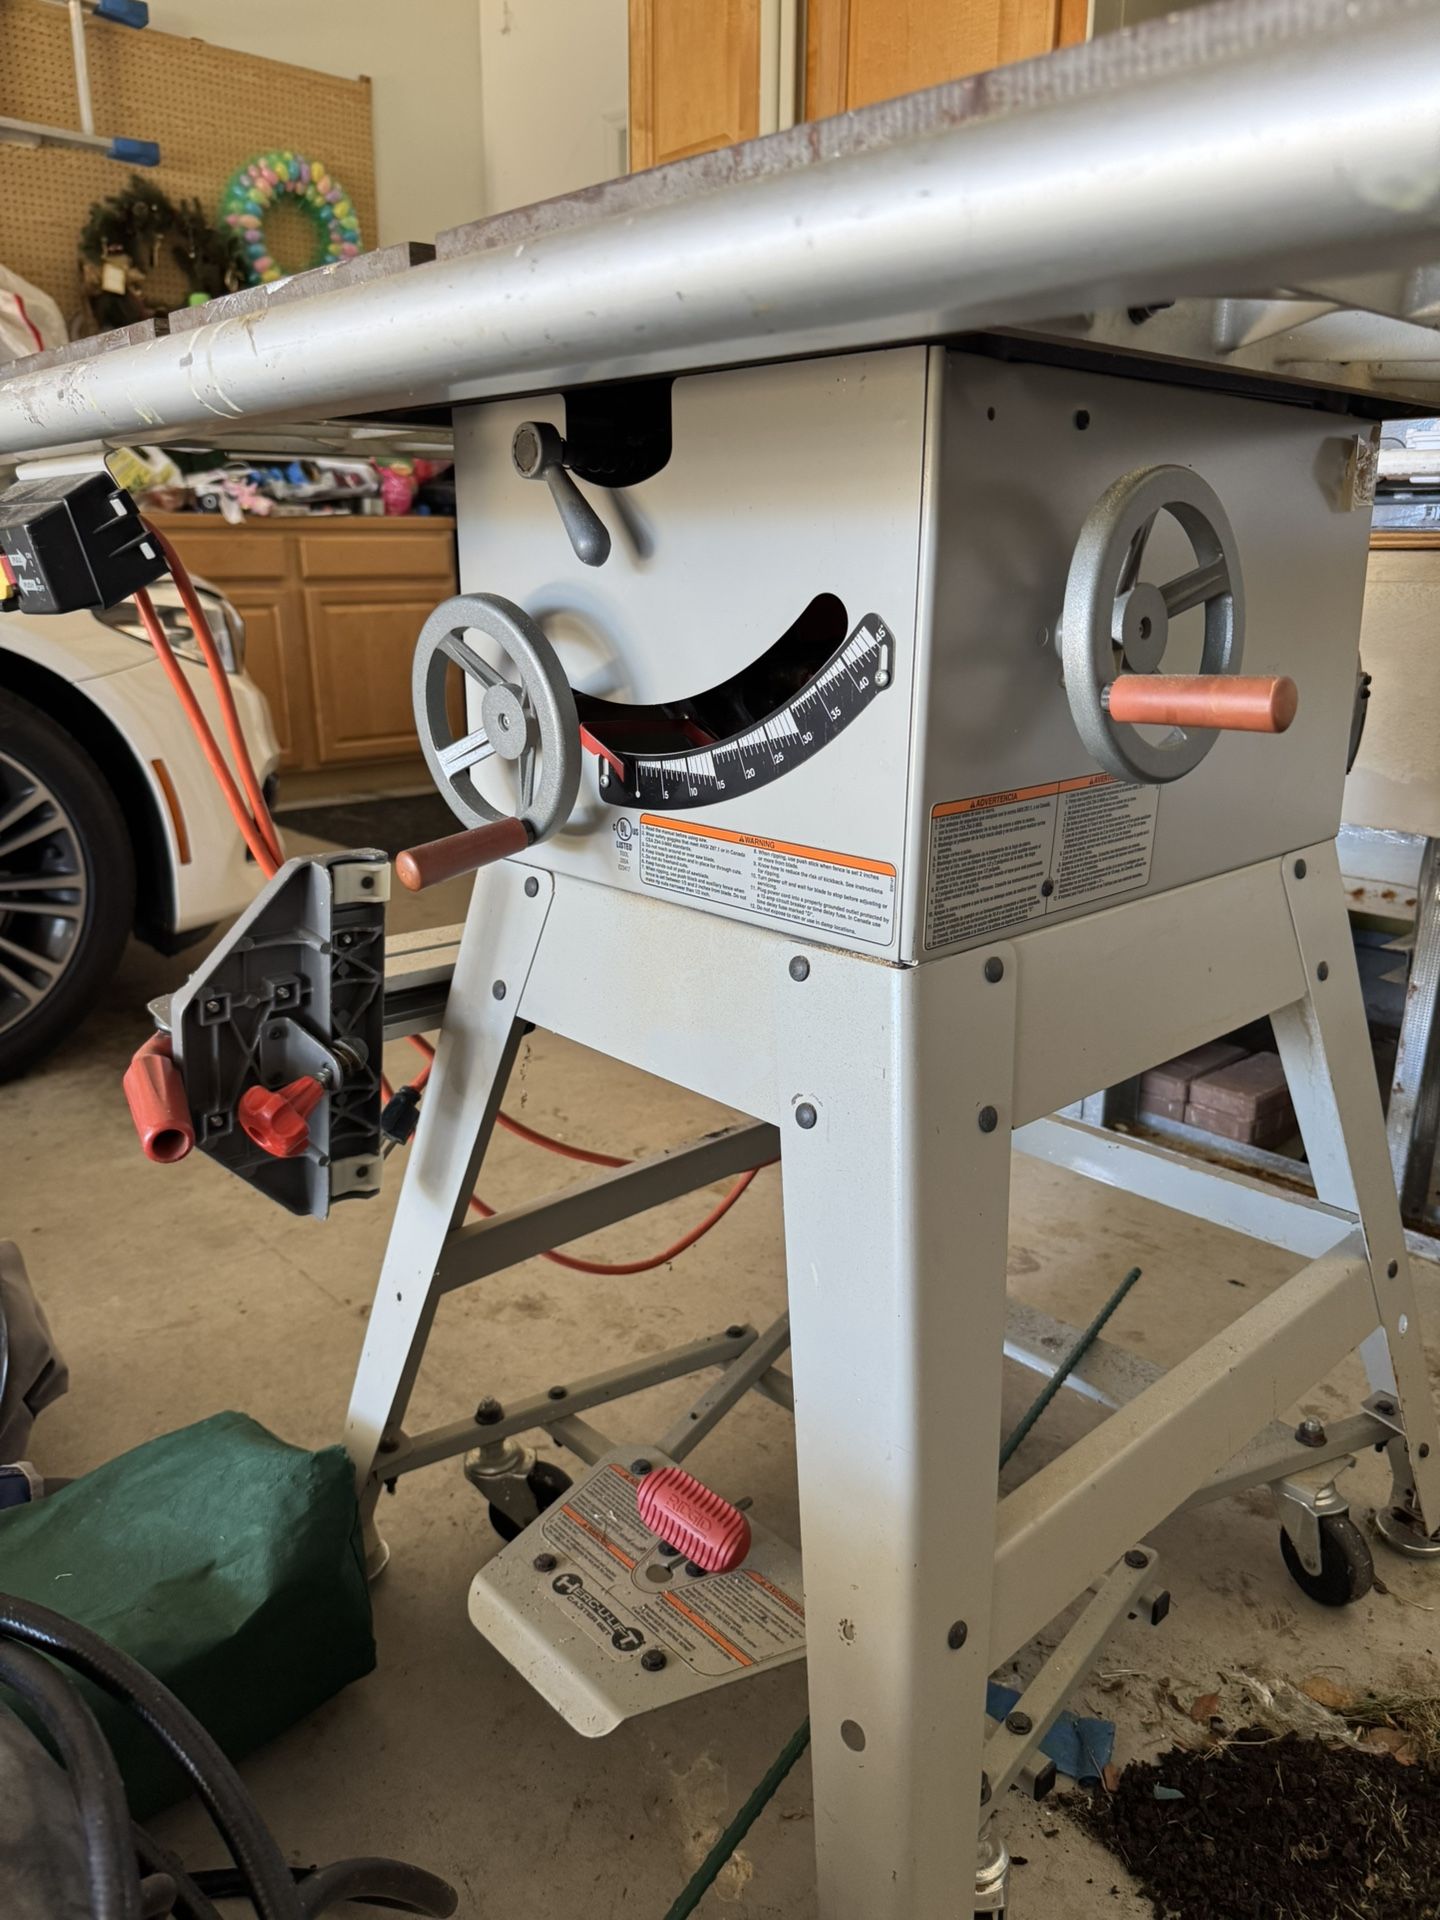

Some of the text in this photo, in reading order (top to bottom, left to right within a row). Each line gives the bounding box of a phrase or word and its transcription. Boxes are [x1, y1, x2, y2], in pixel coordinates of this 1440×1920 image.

[860, 676, 869, 690] 40
[830, 706, 841, 720] 35
[802, 732, 812, 744] 30
[774, 752, 784, 764] 25
[746, 768, 755, 778] 20
[717, 780, 726, 790] 15
[664, 791, 668, 799] 5
[690, 788, 698, 796] 10
[976, 793, 1018, 808] ADVERTENCIA
[616, 840, 632, 851] LISTED
[745, 836, 774, 848] WARNING
[666, 1494, 712, 1532] RIDGID
[566, 1596, 611, 1636] CASTER SET
